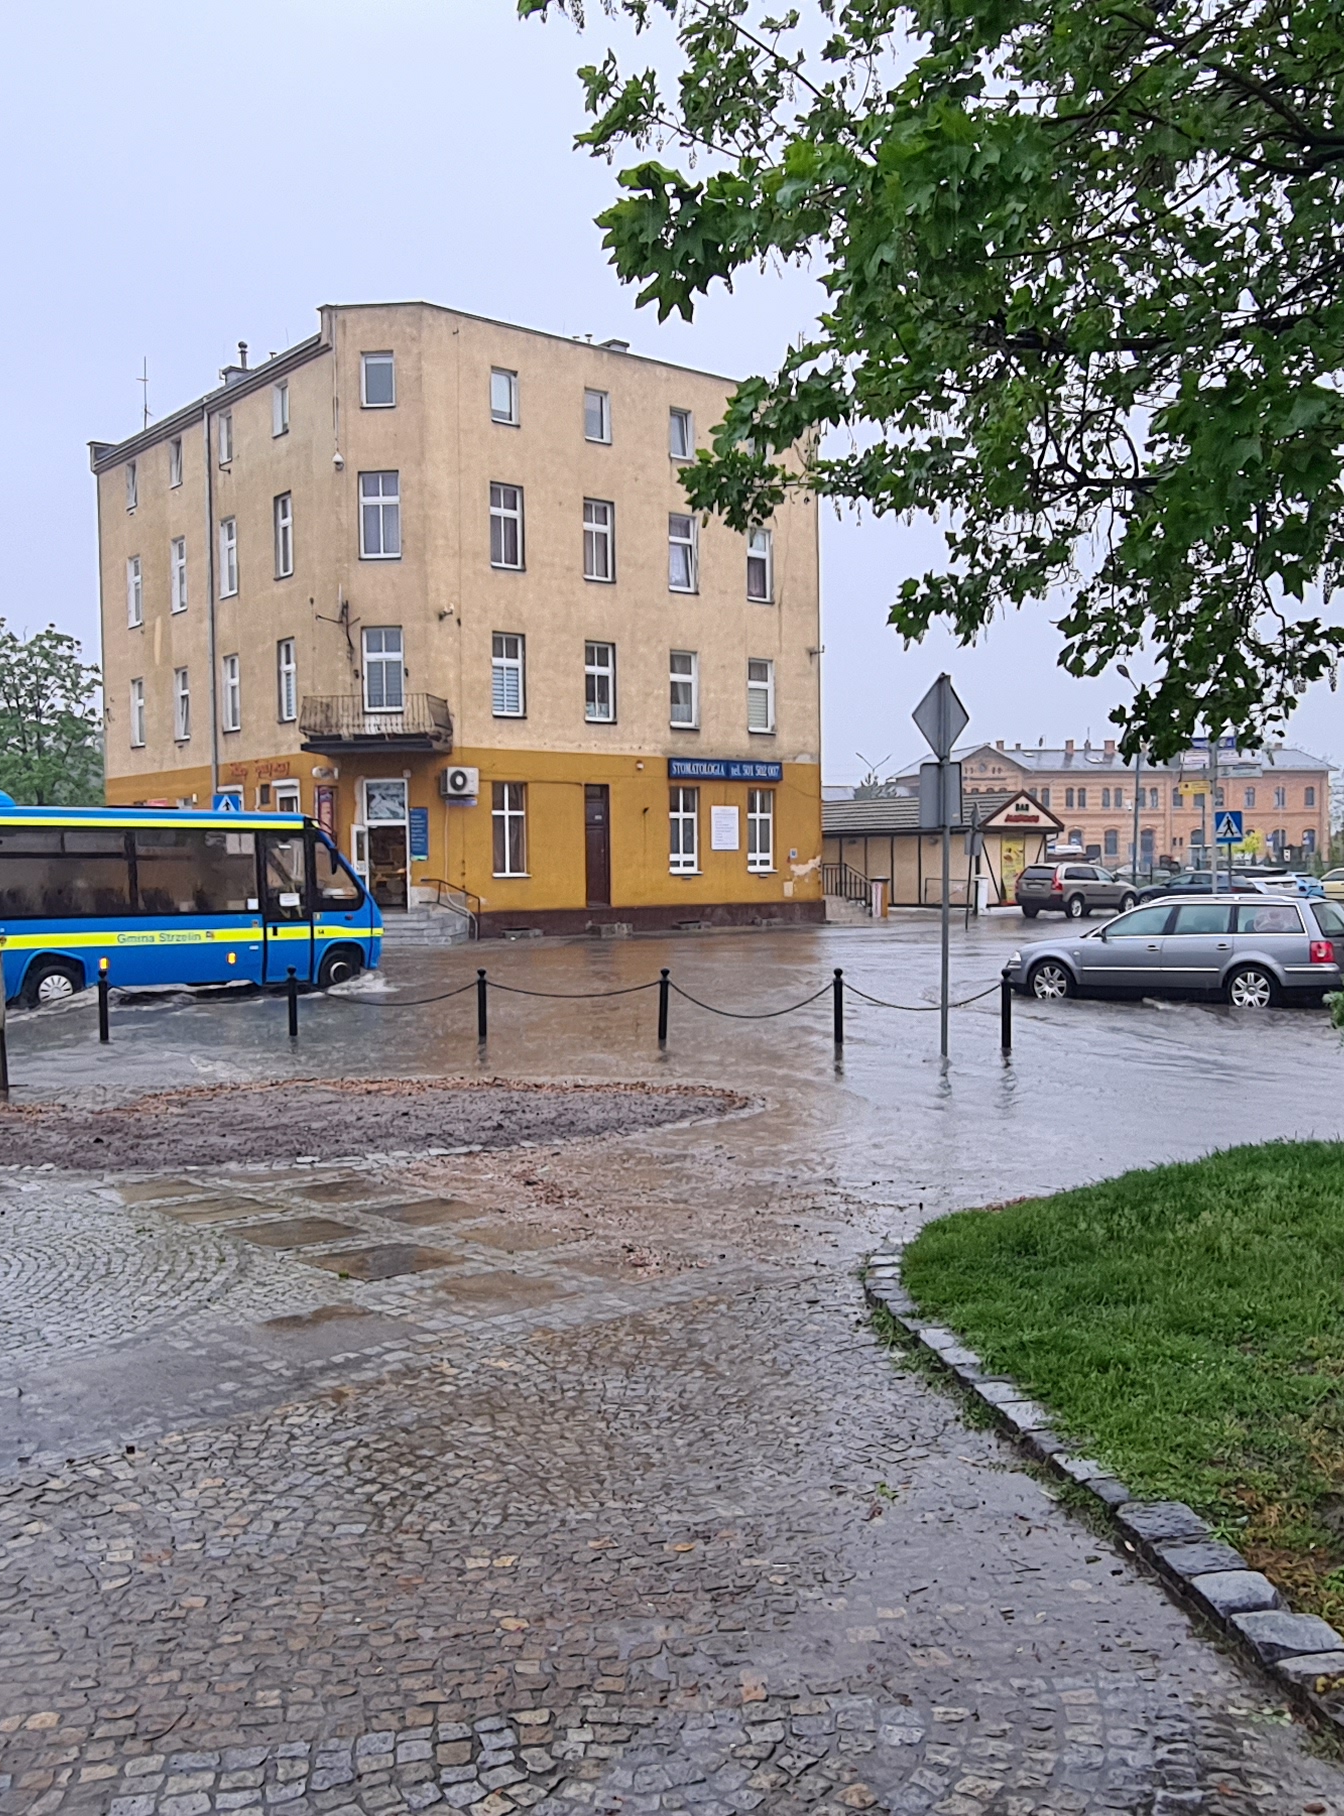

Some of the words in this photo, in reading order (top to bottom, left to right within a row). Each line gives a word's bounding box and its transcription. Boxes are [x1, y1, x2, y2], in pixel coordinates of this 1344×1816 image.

[672, 762, 725, 776] STOMATOLOGIA
[117, 934, 155, 944] Gmina
[159, 931, 202, 943] Strzelin
